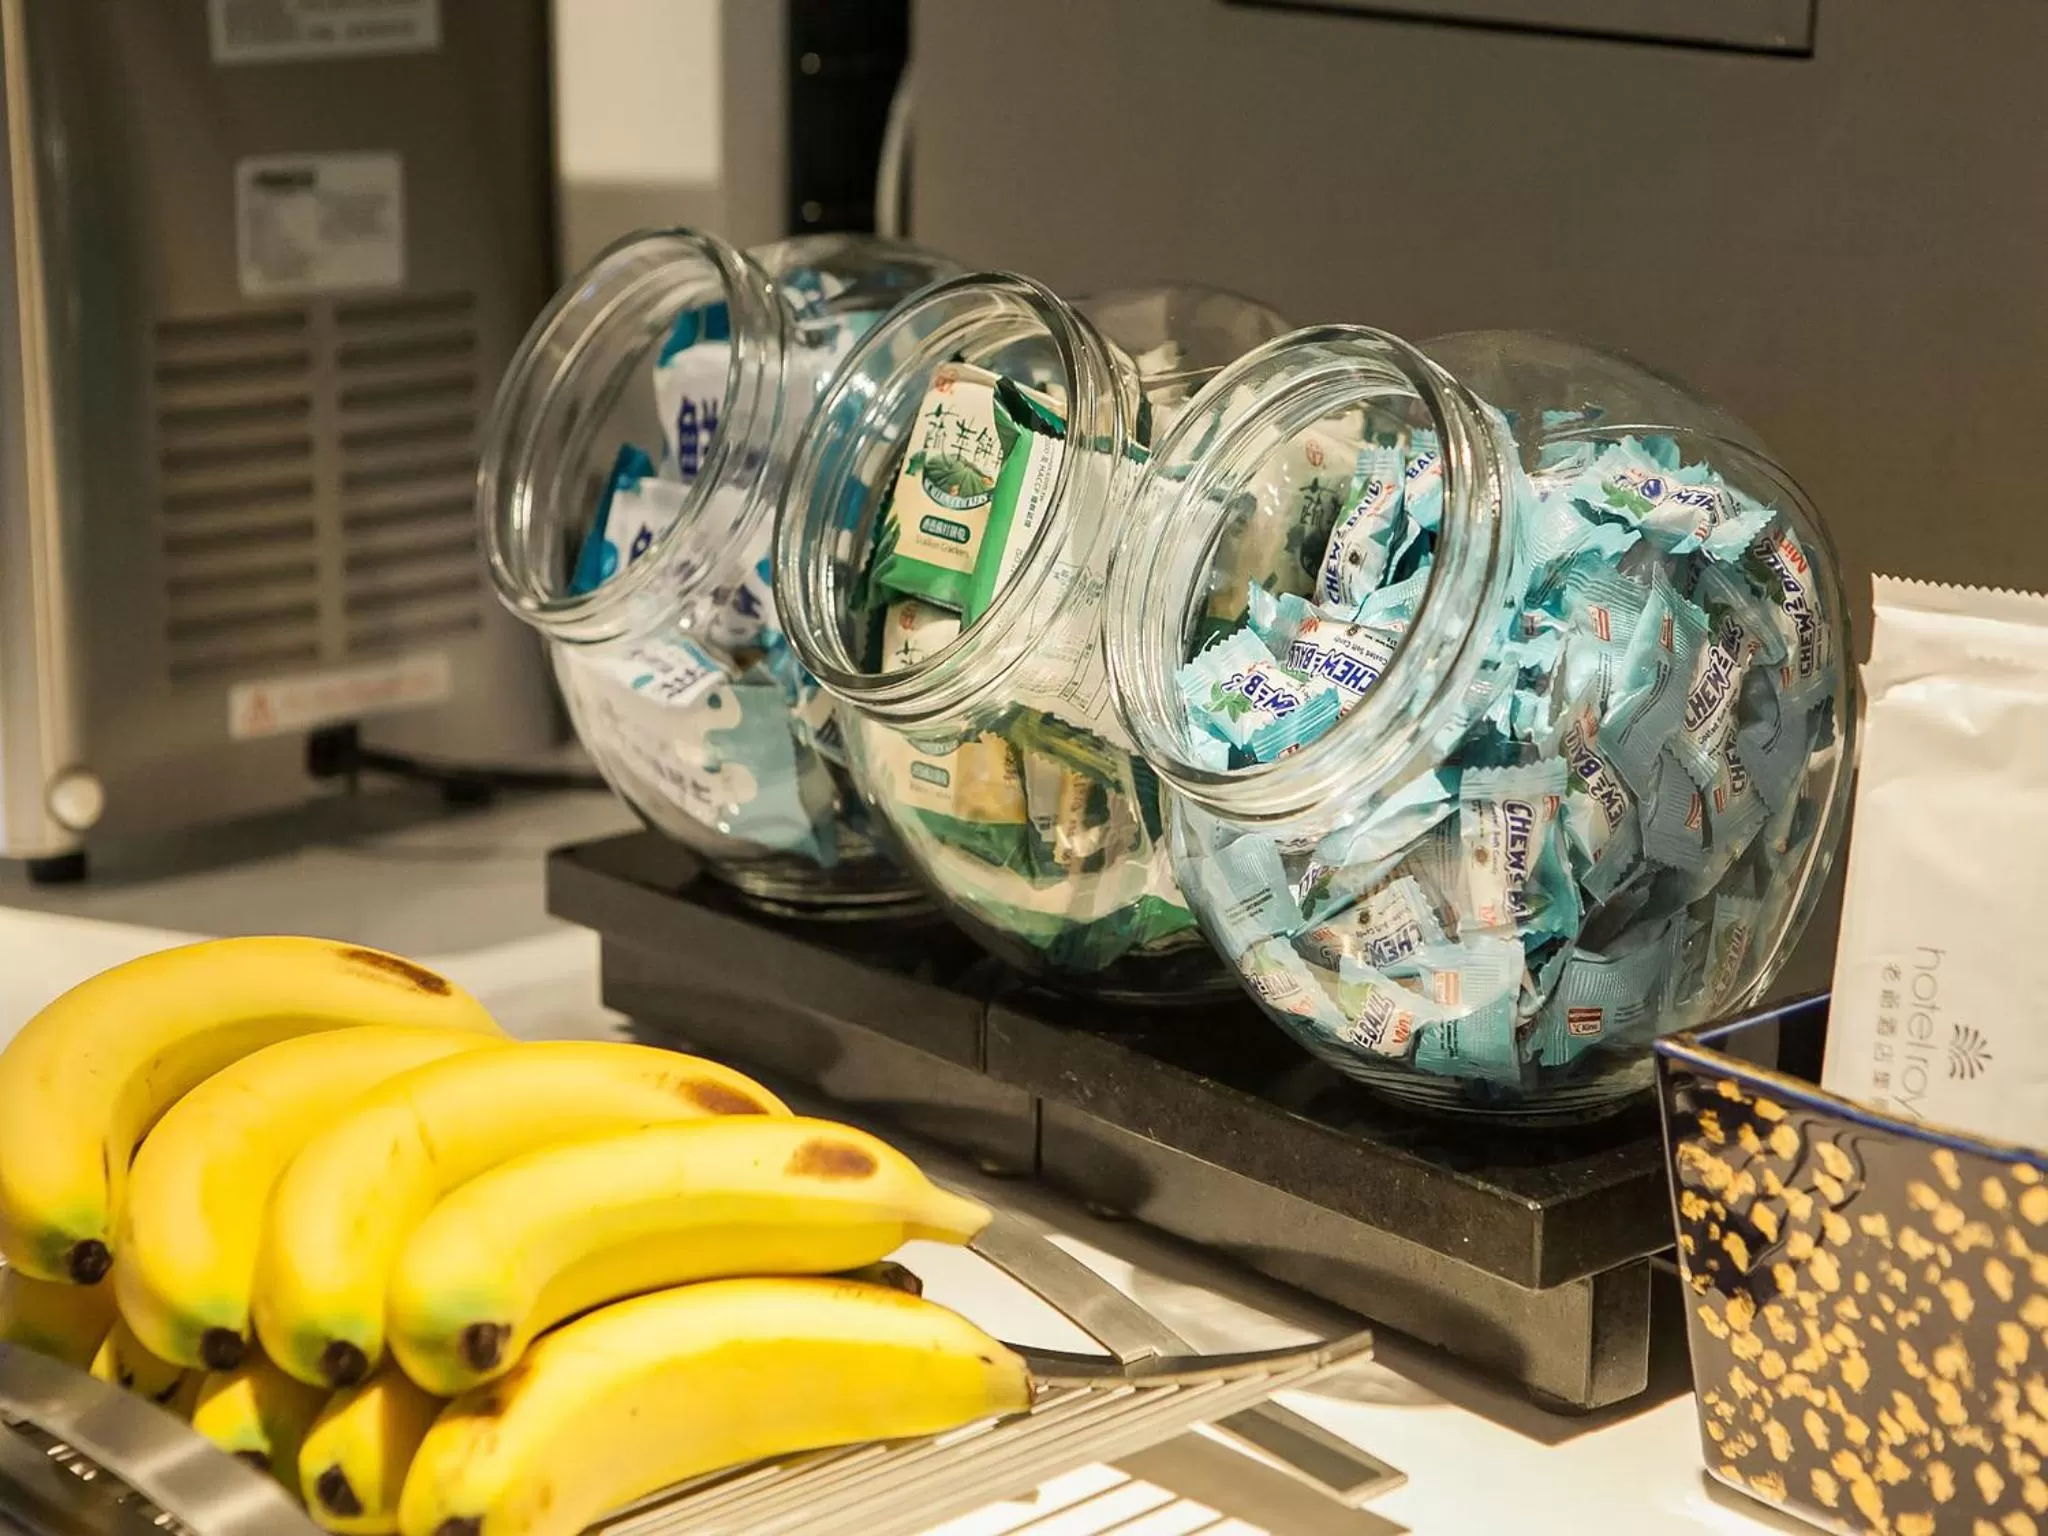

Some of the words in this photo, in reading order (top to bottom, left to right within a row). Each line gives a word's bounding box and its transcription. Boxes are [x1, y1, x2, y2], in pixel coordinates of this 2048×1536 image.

[1324, 541, 1342, 605] CHEW
[1321, 652, 1380, 694] CHEW
[1795, 613, 1816, 675] CHEW
[1685, 663, 1728, 730] CHEW
[1504, 801, 1534, 870] CHEW
[1904, 945, 1947, 1050] hotel
